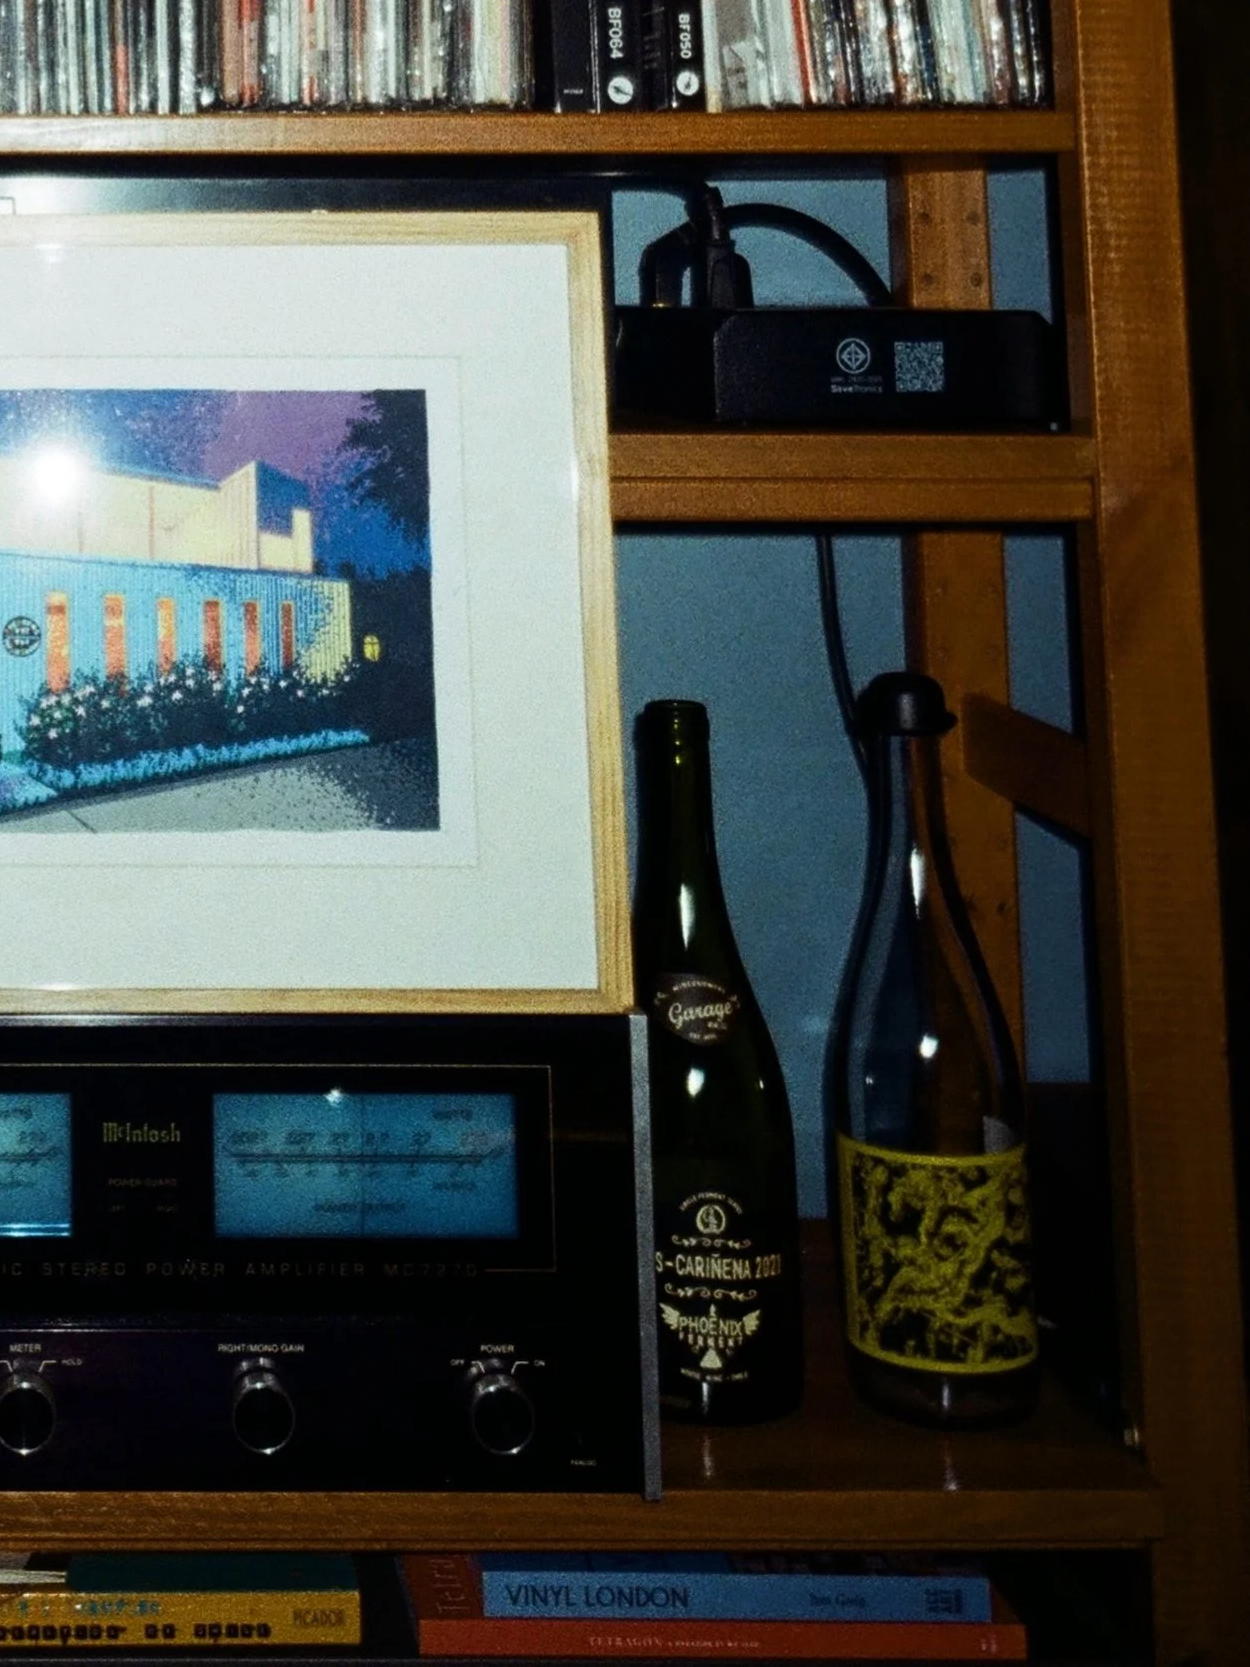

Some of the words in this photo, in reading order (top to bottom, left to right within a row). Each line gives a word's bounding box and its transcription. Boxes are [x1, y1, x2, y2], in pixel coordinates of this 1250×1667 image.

[607, 7, 624, 60] BF064
[678, 13, 692, 60] BF050
[668, 1002, 733, 1029] Garage
[102, 1121, 181, 1143] McIntosh
[41, 1263, 127, 1277] STEREO
[146, 1263, 226, 1277] POWER
[244, 1263, 366, 1277] AMPLIFIER
[8, 1343, 42, 1353] METER
[281, 1344, 305, 1353] GAIN
[480, 1344, 515, 1353] POWER
[505, 1585, 576, 1607] VINYL
[585, 1585, 690, 1608] LONDON
[293, 1609, 345, 1628] PICADOR
